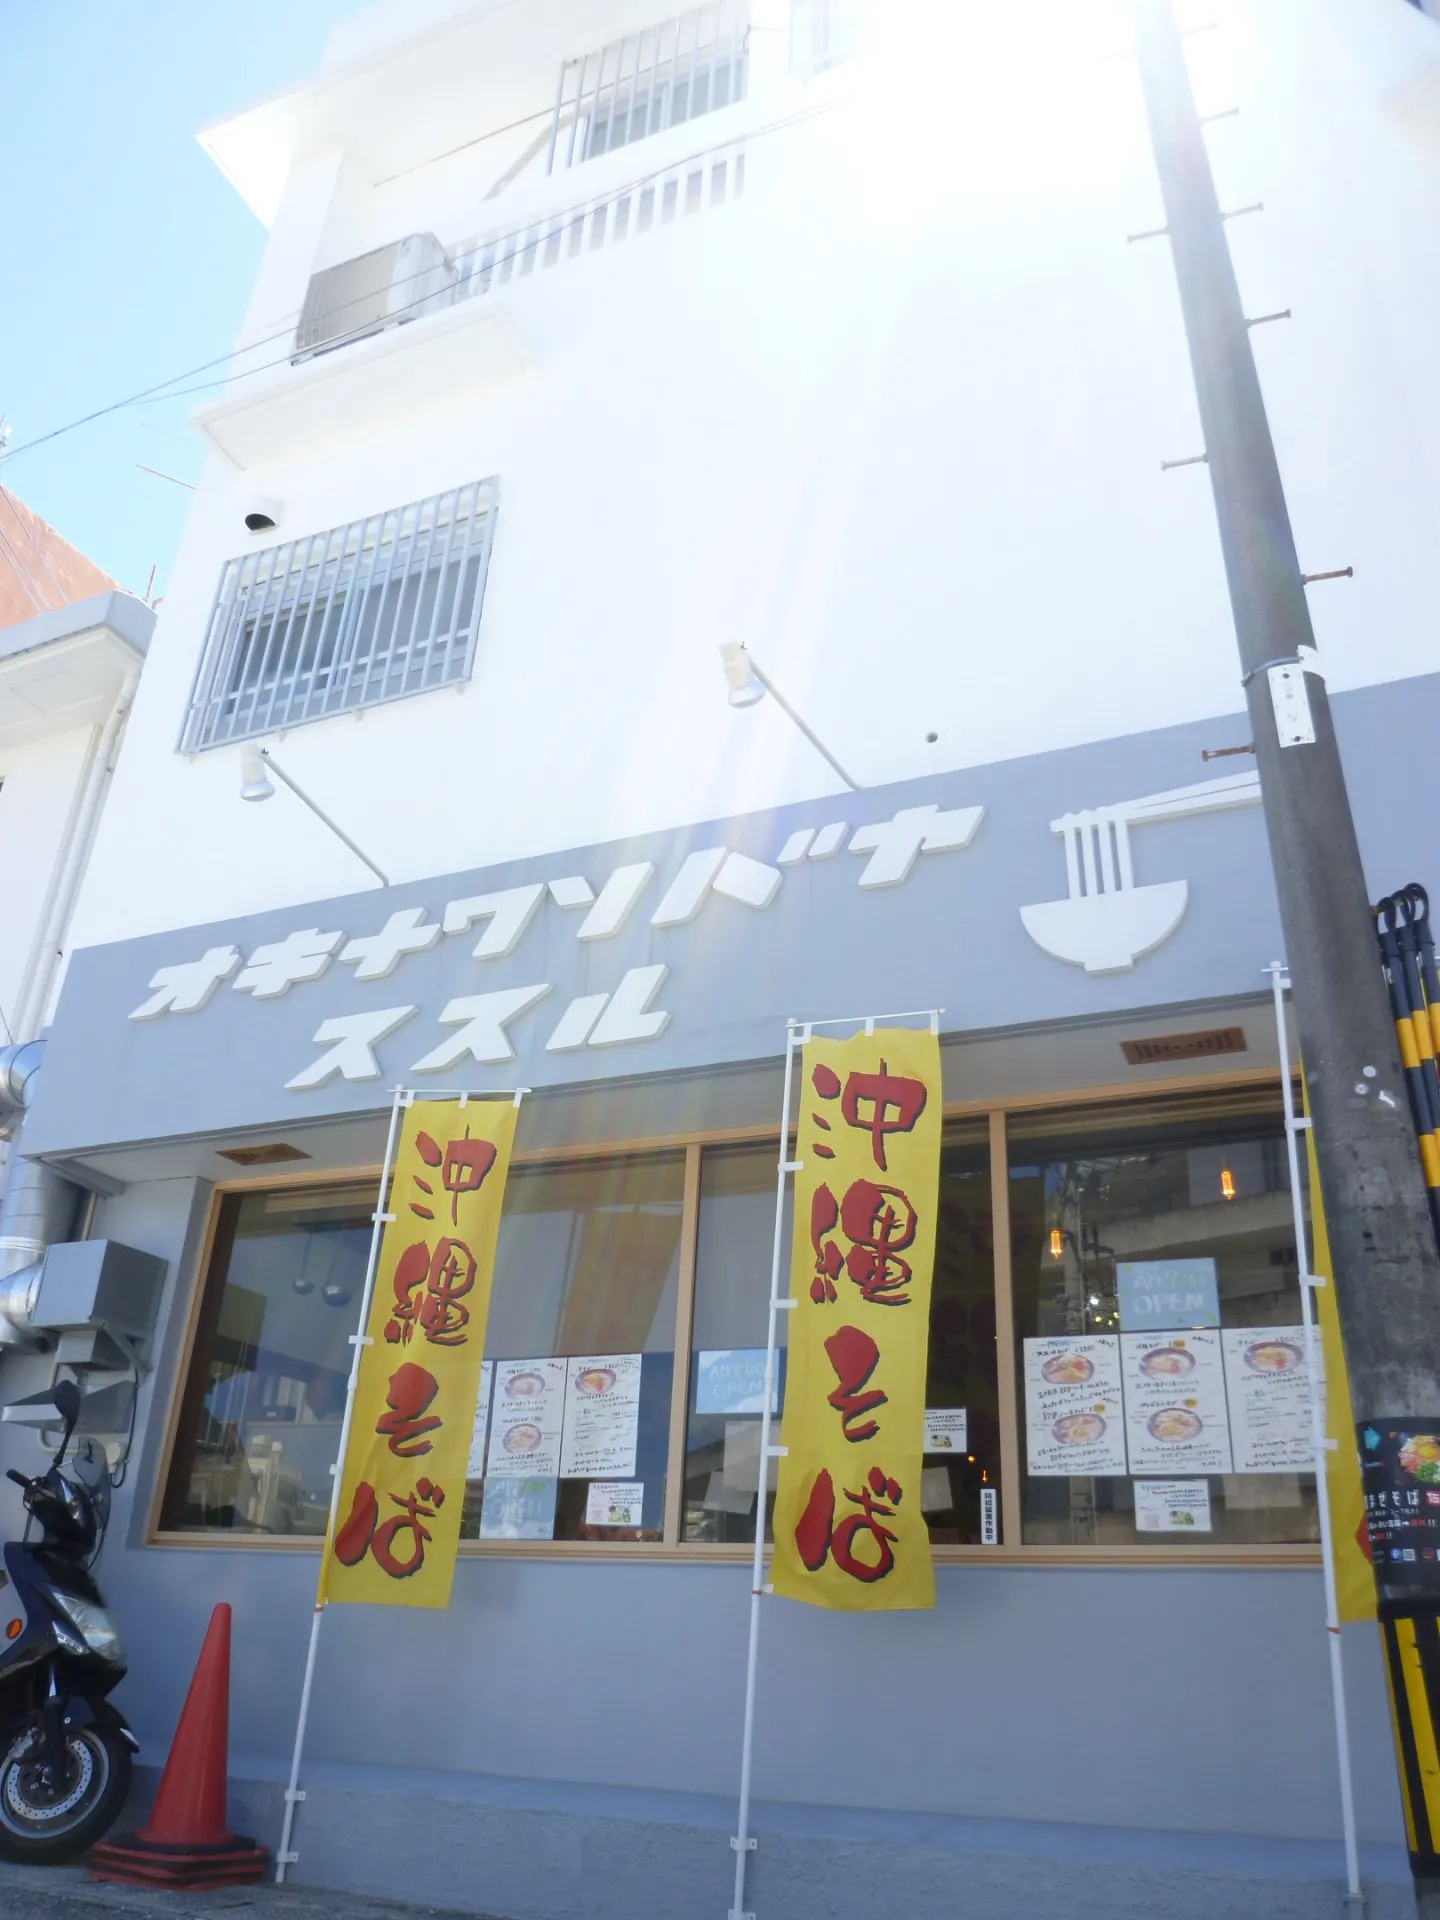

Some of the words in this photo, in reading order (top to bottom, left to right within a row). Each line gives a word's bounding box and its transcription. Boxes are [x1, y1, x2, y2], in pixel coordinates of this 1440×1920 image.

[128, 804, 985, 1020] オキナワソバヤ
[284, 964, 671, 1090] ススル
[334, 1124, 498, 1579] 沖縄そば
[794, 1058, 927, 1583] 沖縄そば
[1132, 1292, 1205, 1314] OPEN
